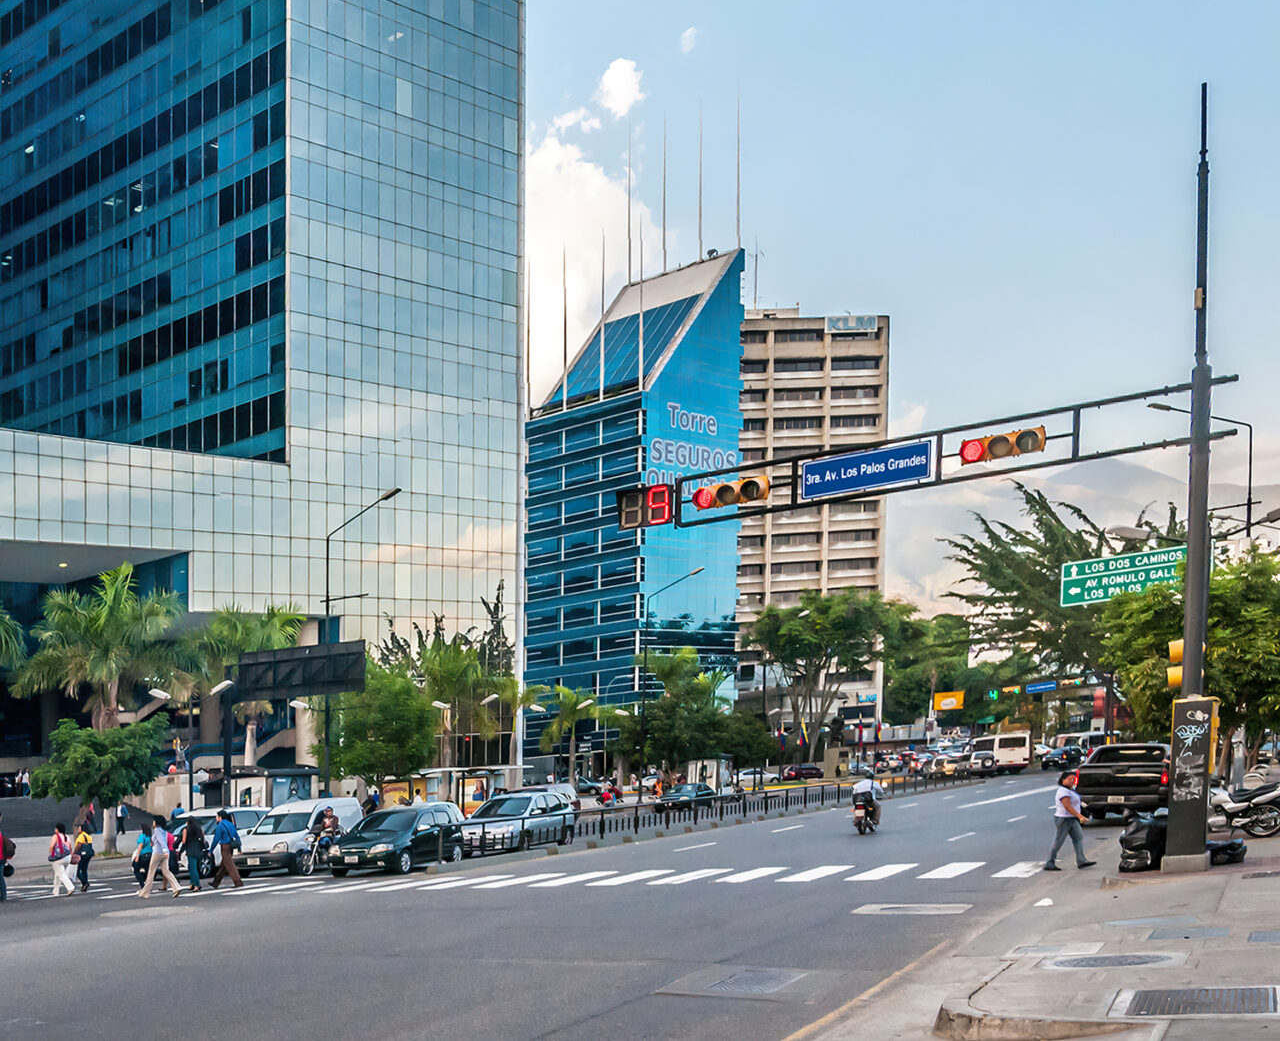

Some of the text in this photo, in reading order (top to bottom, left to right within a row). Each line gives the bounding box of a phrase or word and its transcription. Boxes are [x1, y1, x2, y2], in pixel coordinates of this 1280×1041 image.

[827, 317, 877, 331] KLM
[667, 402, 718, 435] Torre
[651, 438, 737, 470] SEGUROS
[806, 455, 927, 485] 3ra. Av. Los Palos Grandes
[1085, 551, 1183, 574] LOS DOS CAMINOS
[1102, 572, 1145, 586] ROMULO
[1150, 568, 1177, 580] GALL
[1084, 589, 1104, 600] LOS
